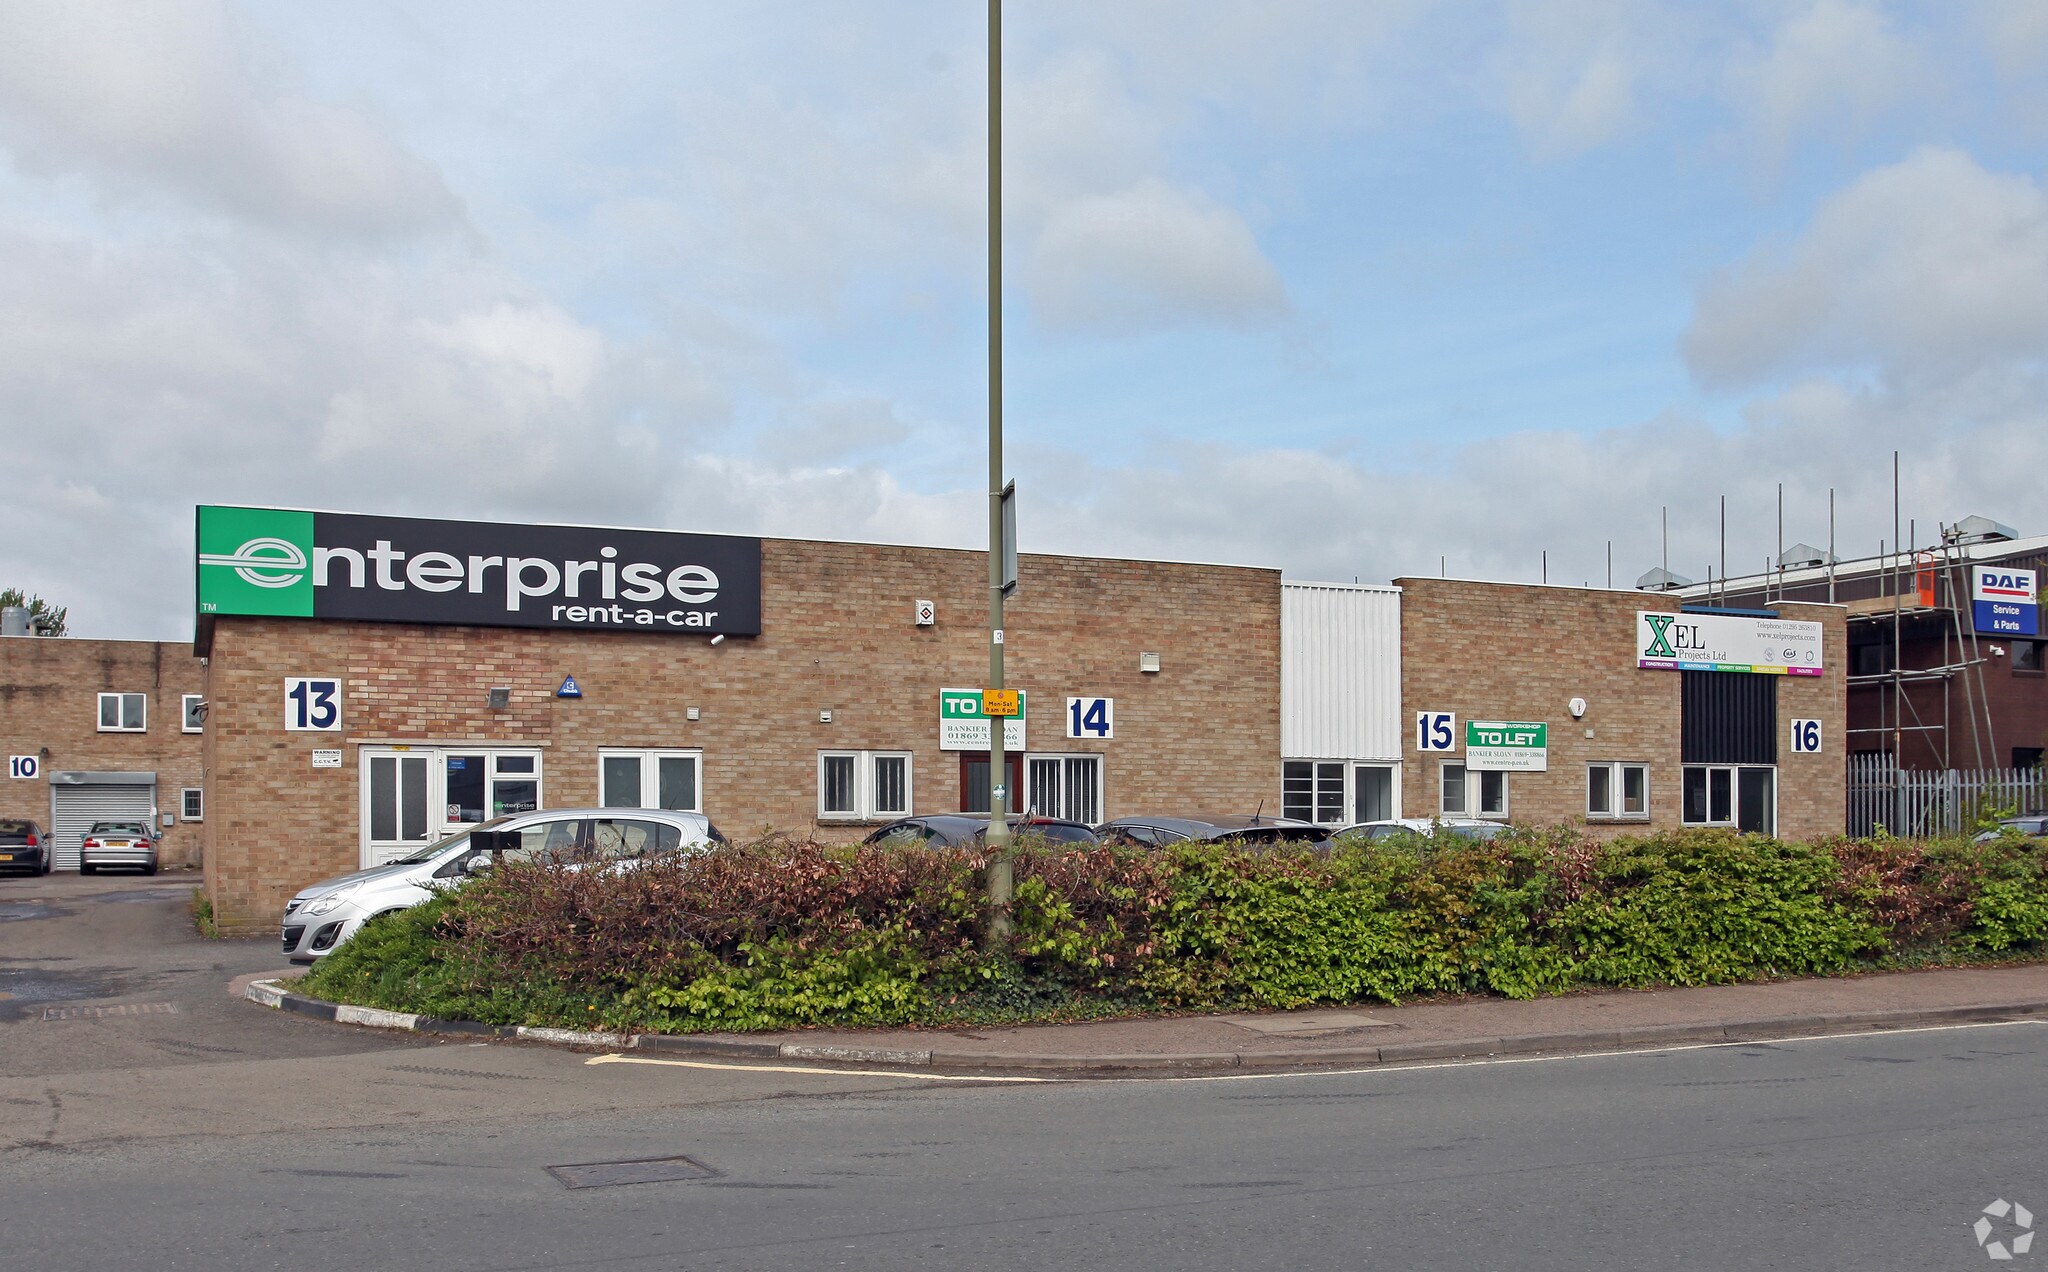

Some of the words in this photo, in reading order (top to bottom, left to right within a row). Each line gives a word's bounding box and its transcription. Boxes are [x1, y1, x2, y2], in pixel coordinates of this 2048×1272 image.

[199, 536, 720, 612] enterprise
[1981, 573, 2030, 589] DAF
[202, 603, 217, 611] TM
[1993, 604, 2020, 615] Service
[552, 604, 719, 627] rent-a-car
[1756, 621, 1782, 630] Telephone
[1993, 620, 2000, 629] &
[2001, 620, 2020, 631] Parts
[996, 632, 1003, 641] 3
[1644, 614, 1706, 658] XEL
[1678, 648, 1711, 661] Projects
[1712, 650, 1727, 661] Ltd
[289, 681, 337, 729] 13
[945, 698, 977, 714] TO
[1070, 699, 1110, 737] 14
[947, 725, 988, 733] BANKIER
[948, 732, 979, 740] 01869
[1419, 713, 1453, 750] 15
[1793, 720, 1819, 751] 16
[1477, 731, 1502, 745] TO
[1504, 732, 1537, 745] LET
[12, 757, 37, 777] 10
